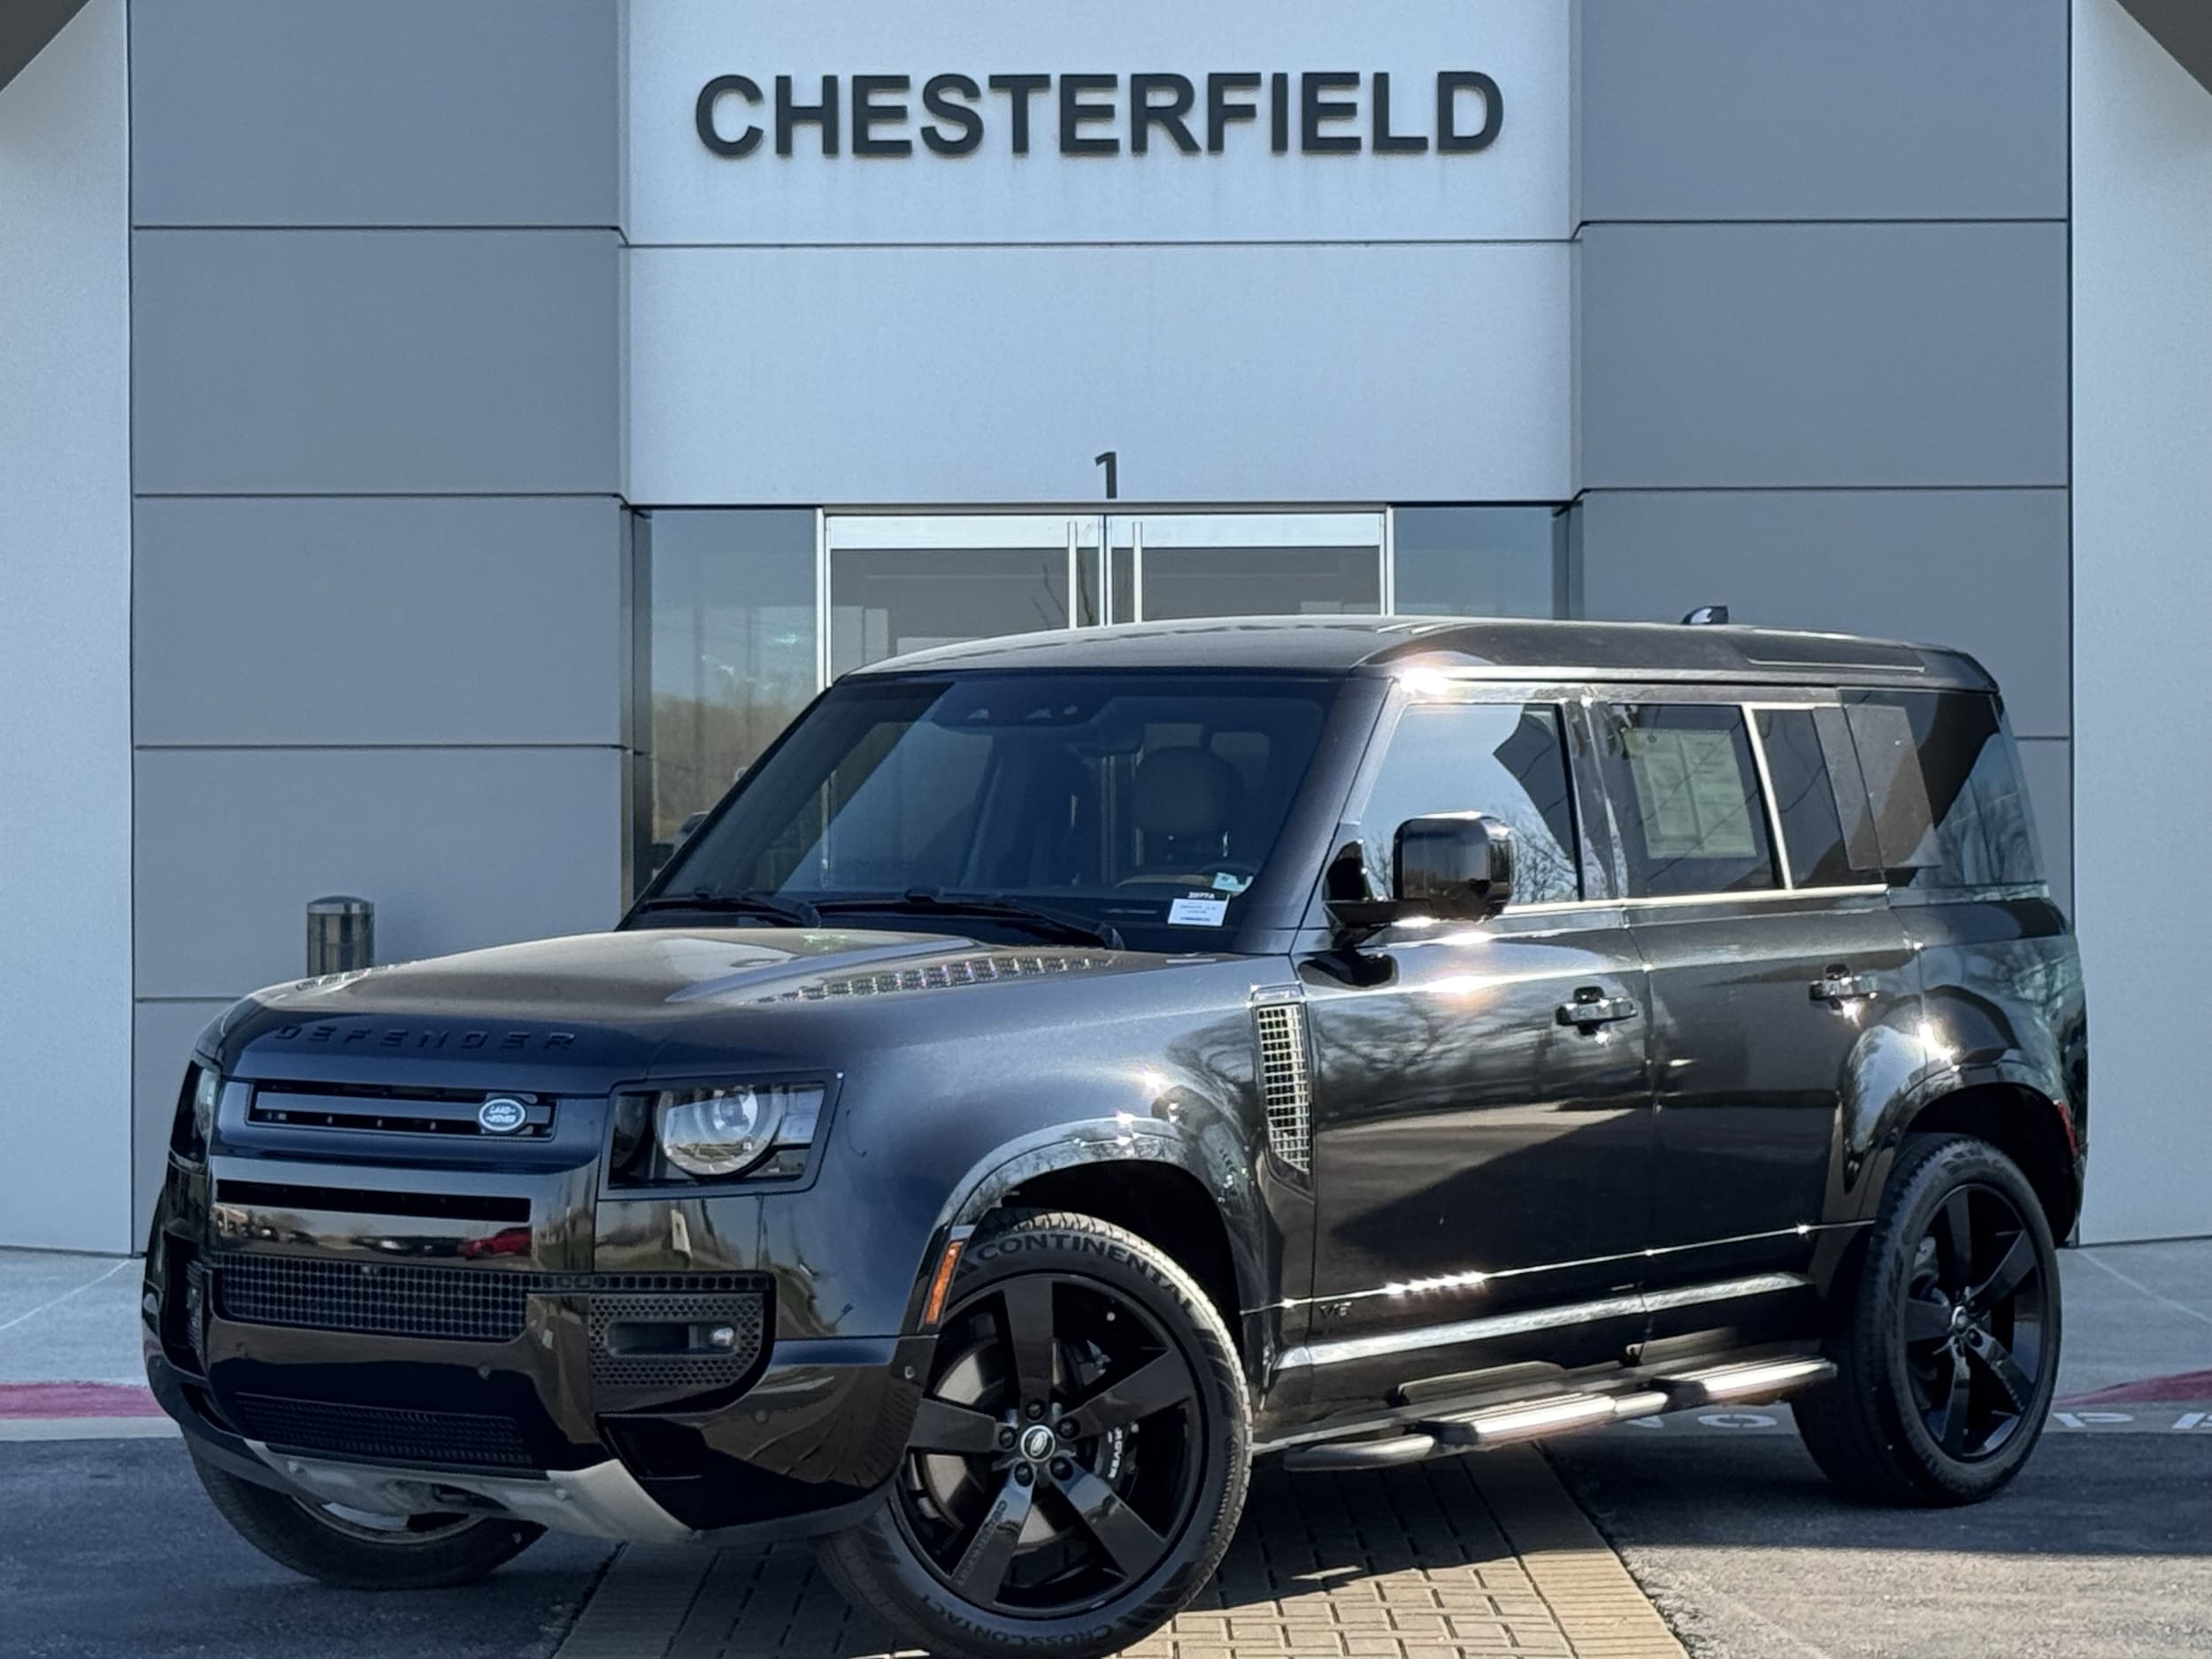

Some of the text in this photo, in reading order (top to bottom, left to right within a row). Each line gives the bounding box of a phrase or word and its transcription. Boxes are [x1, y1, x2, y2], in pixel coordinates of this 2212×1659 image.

[695, 71, 1505, 157] CHESTERFIELD
[1094, 451, 1118, 500] 1
[272, 1024, 577, 1049] DEFENDER
[976, 1233, 1196, 1315] CONTINENTAL
